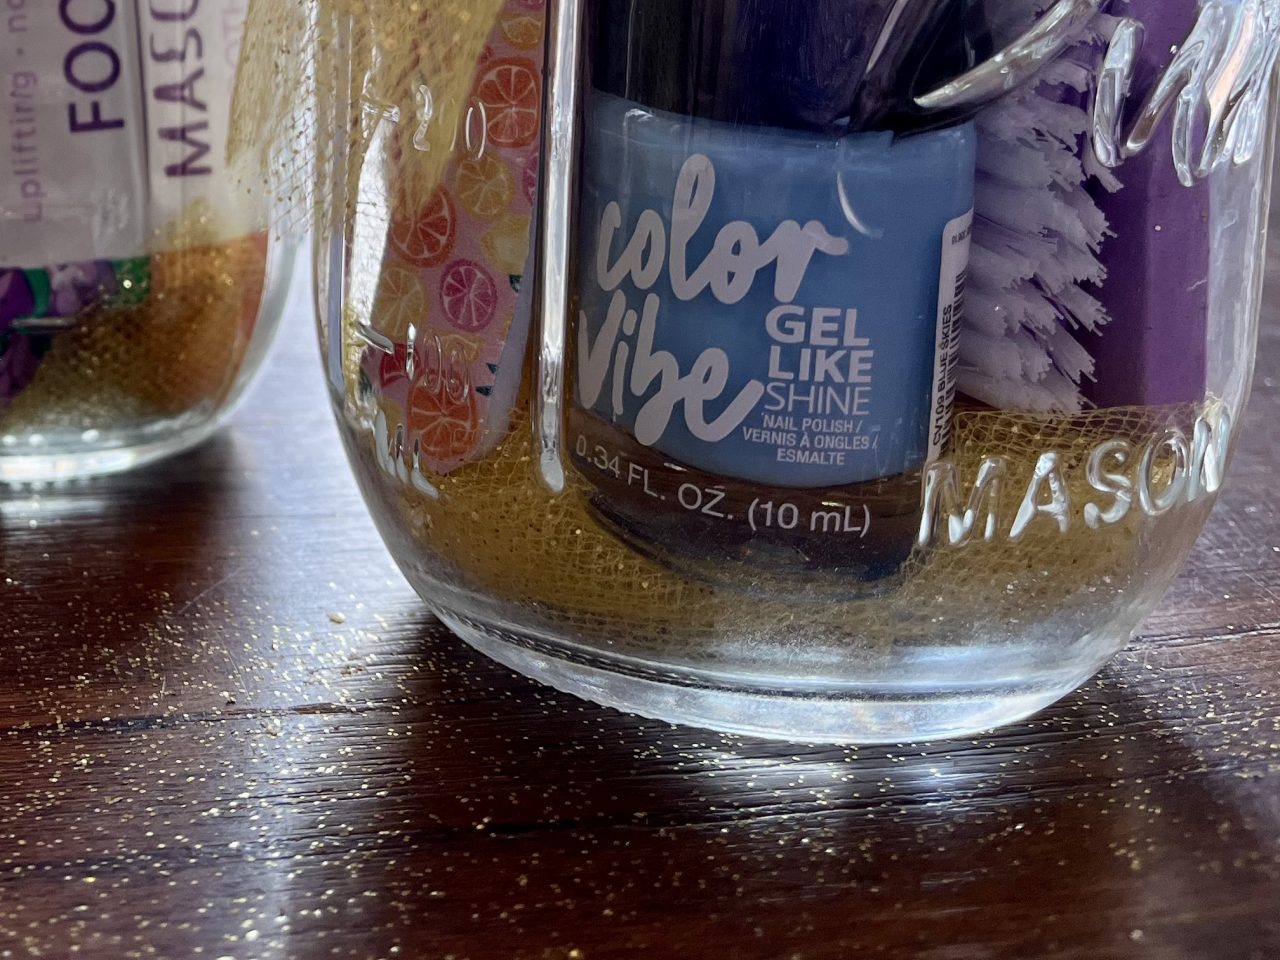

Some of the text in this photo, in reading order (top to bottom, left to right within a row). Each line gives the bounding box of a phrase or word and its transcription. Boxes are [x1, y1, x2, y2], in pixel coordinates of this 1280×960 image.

[597, 153, 849, 304] color
[765, 305, 870, 346] GEL
[939, 303, 953, 352] SKIES
[768, 345, 874, 383] LIKE
[936, 351, 949, 394] BLUE
[764, 381, 872, 416] SHINE
[743, 427, 796, 447] VERNIS
[763, 414, 797, 431] NAIL
[776, 449, 846, 466] ESMALTE
[918, 410, 1231, 546] MASON
[576, 434, 871, 538] 0.34 FL. OZ. (10 mL)
